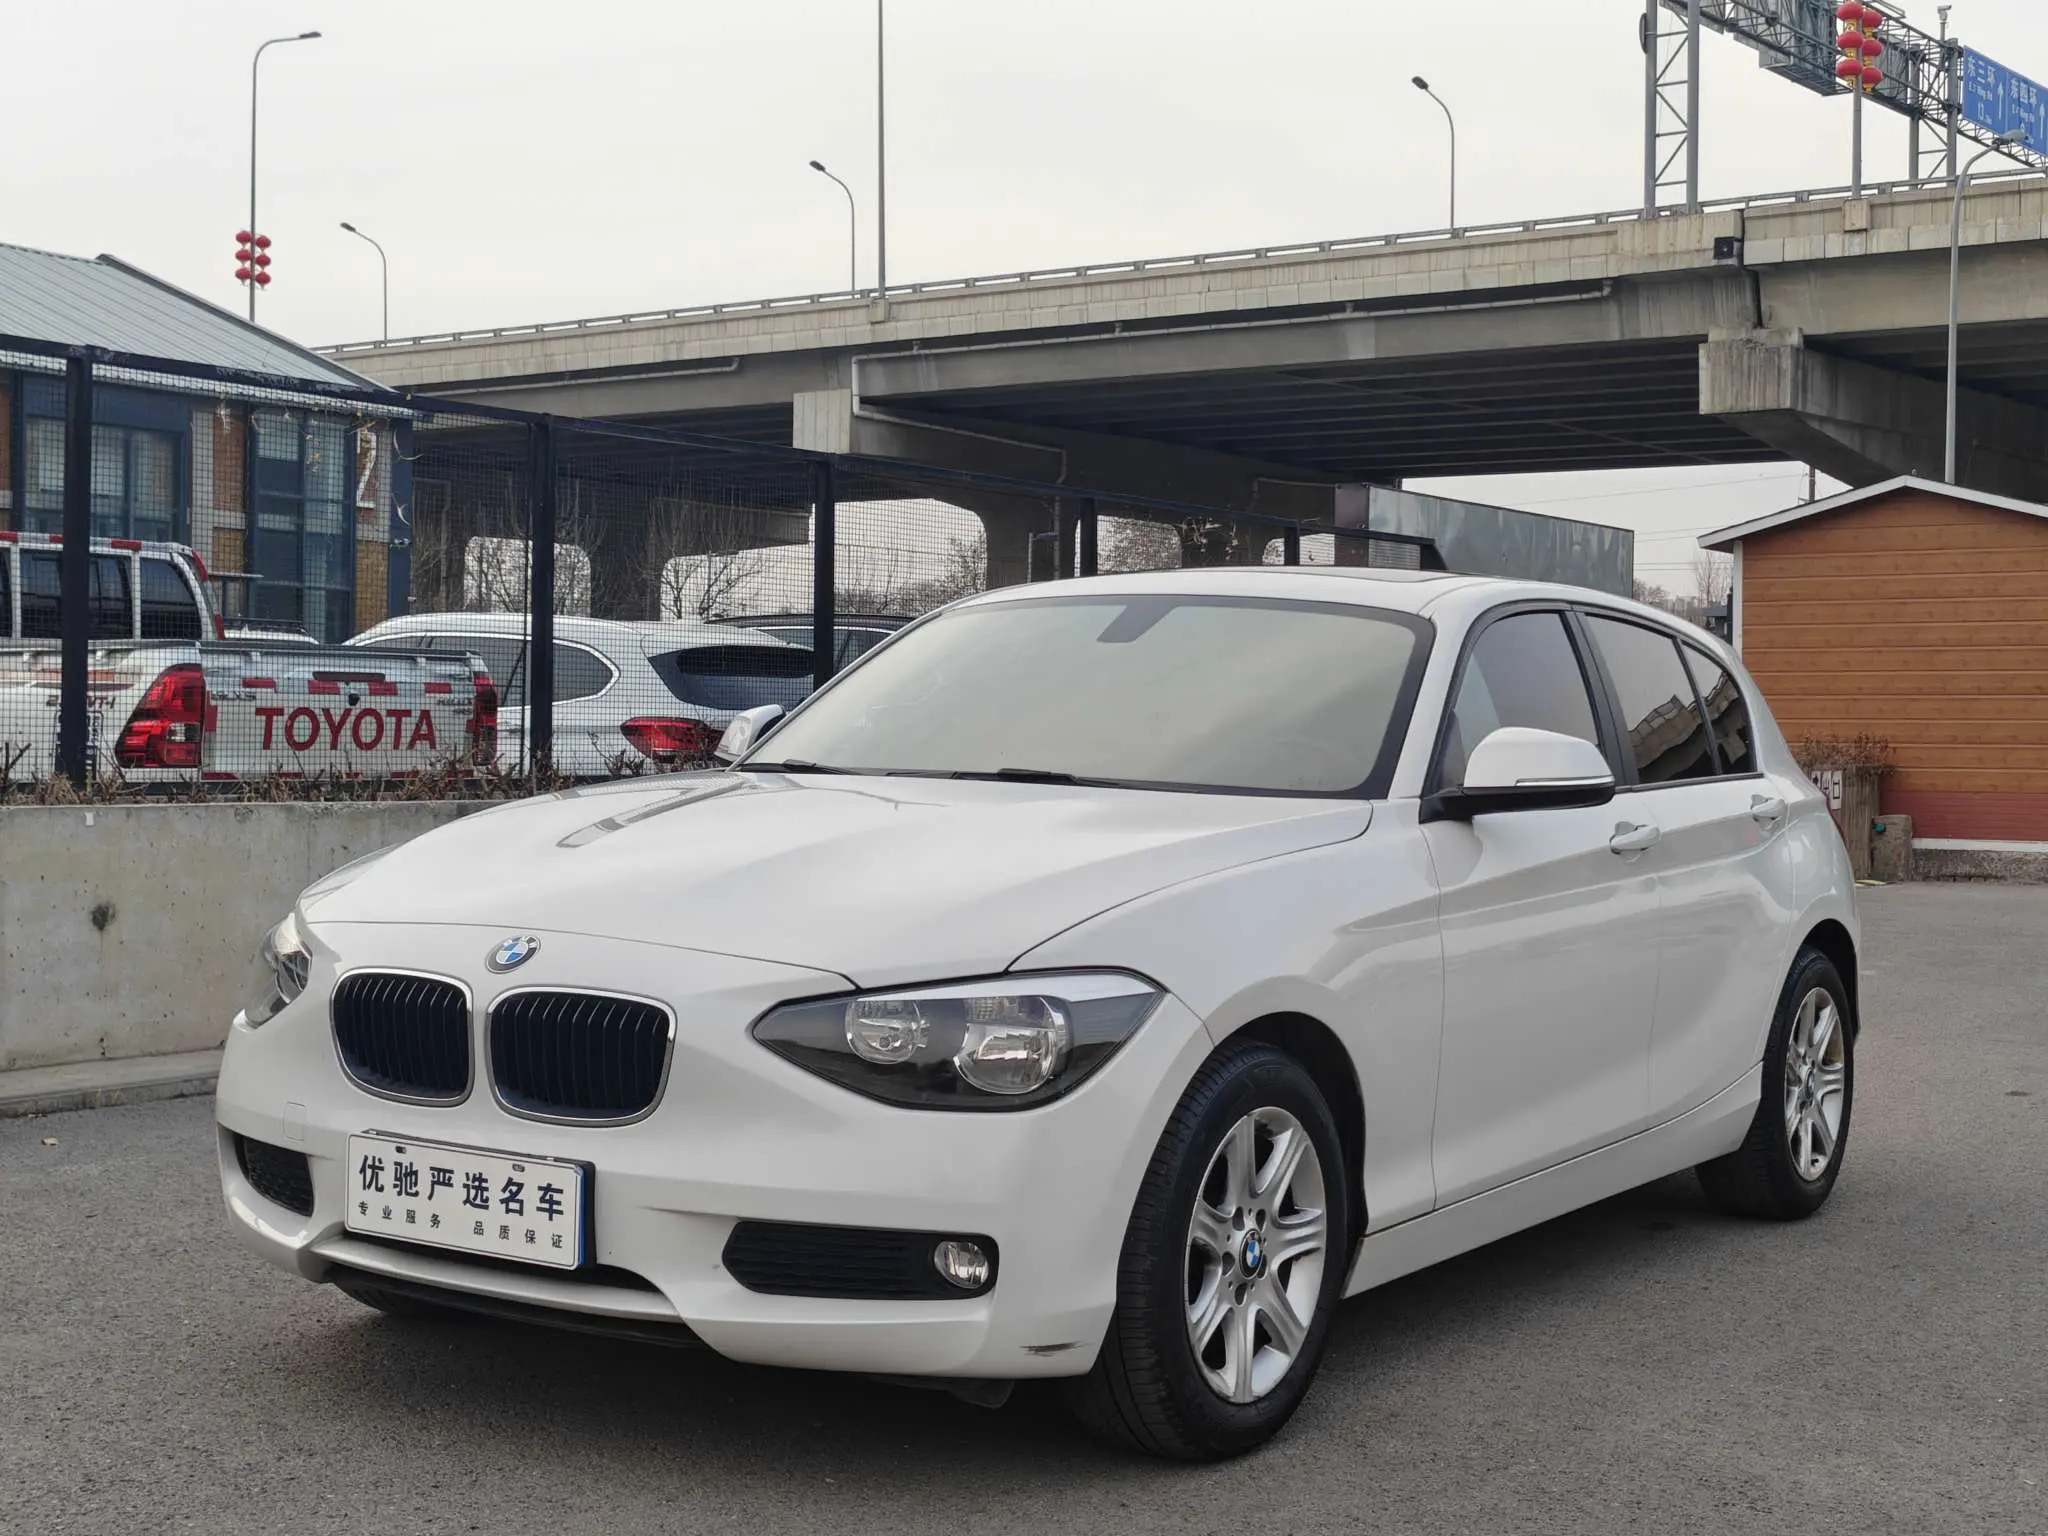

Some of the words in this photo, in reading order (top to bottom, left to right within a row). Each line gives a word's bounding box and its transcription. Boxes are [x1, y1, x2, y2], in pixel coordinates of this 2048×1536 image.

[254, 706, 437, 751] TOYOTA
[358, 1154, 565, 1222] 优驰严选名车
[357, 1200, 441, 1230] 专业服务
[473, 1220, 564, 1249] 品质保证
